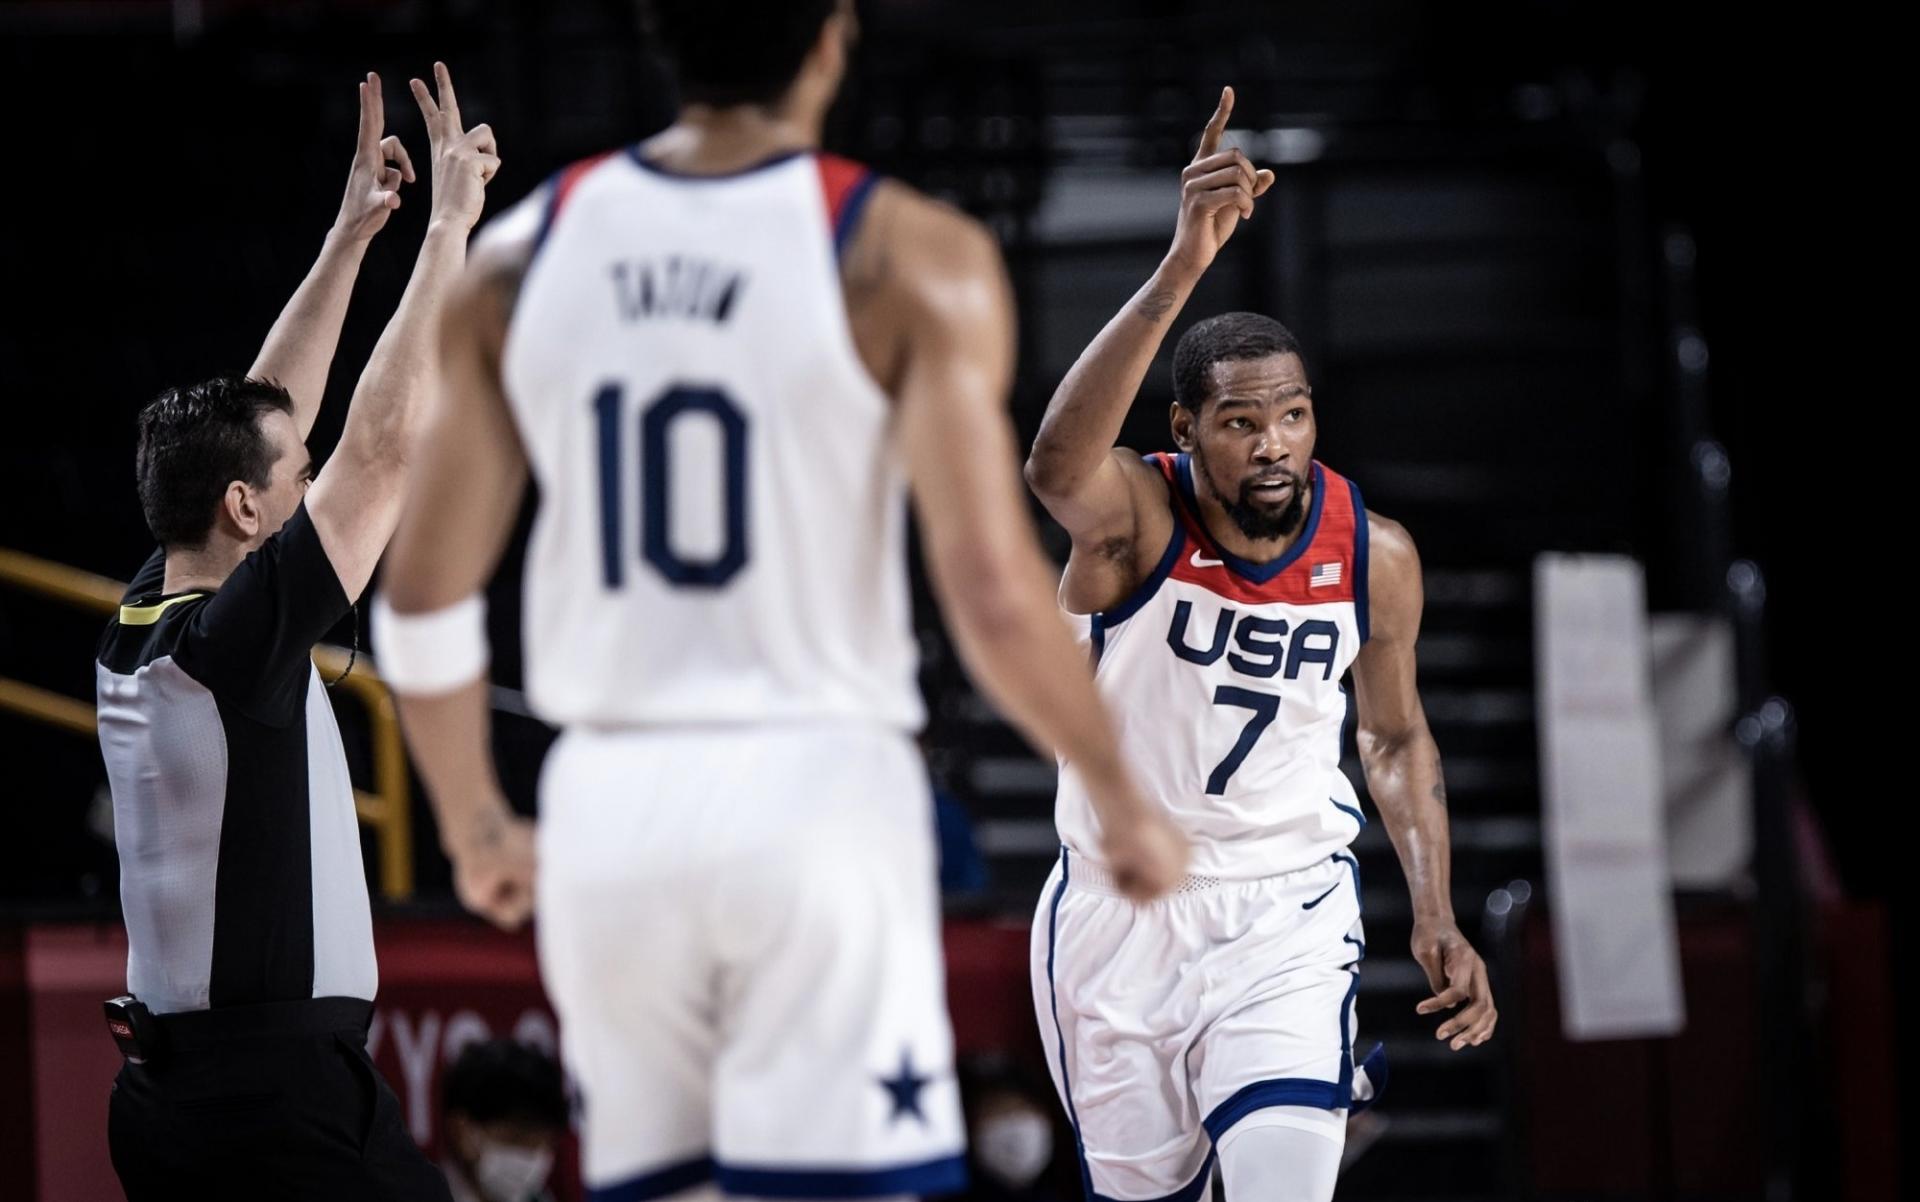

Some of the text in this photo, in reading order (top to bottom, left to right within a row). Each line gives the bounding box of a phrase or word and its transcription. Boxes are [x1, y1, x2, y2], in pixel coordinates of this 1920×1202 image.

[592, 381, 751, 591] 10
[1167, 600, 1340, 680] USA
[1205, 685, 1281, 795] 7
